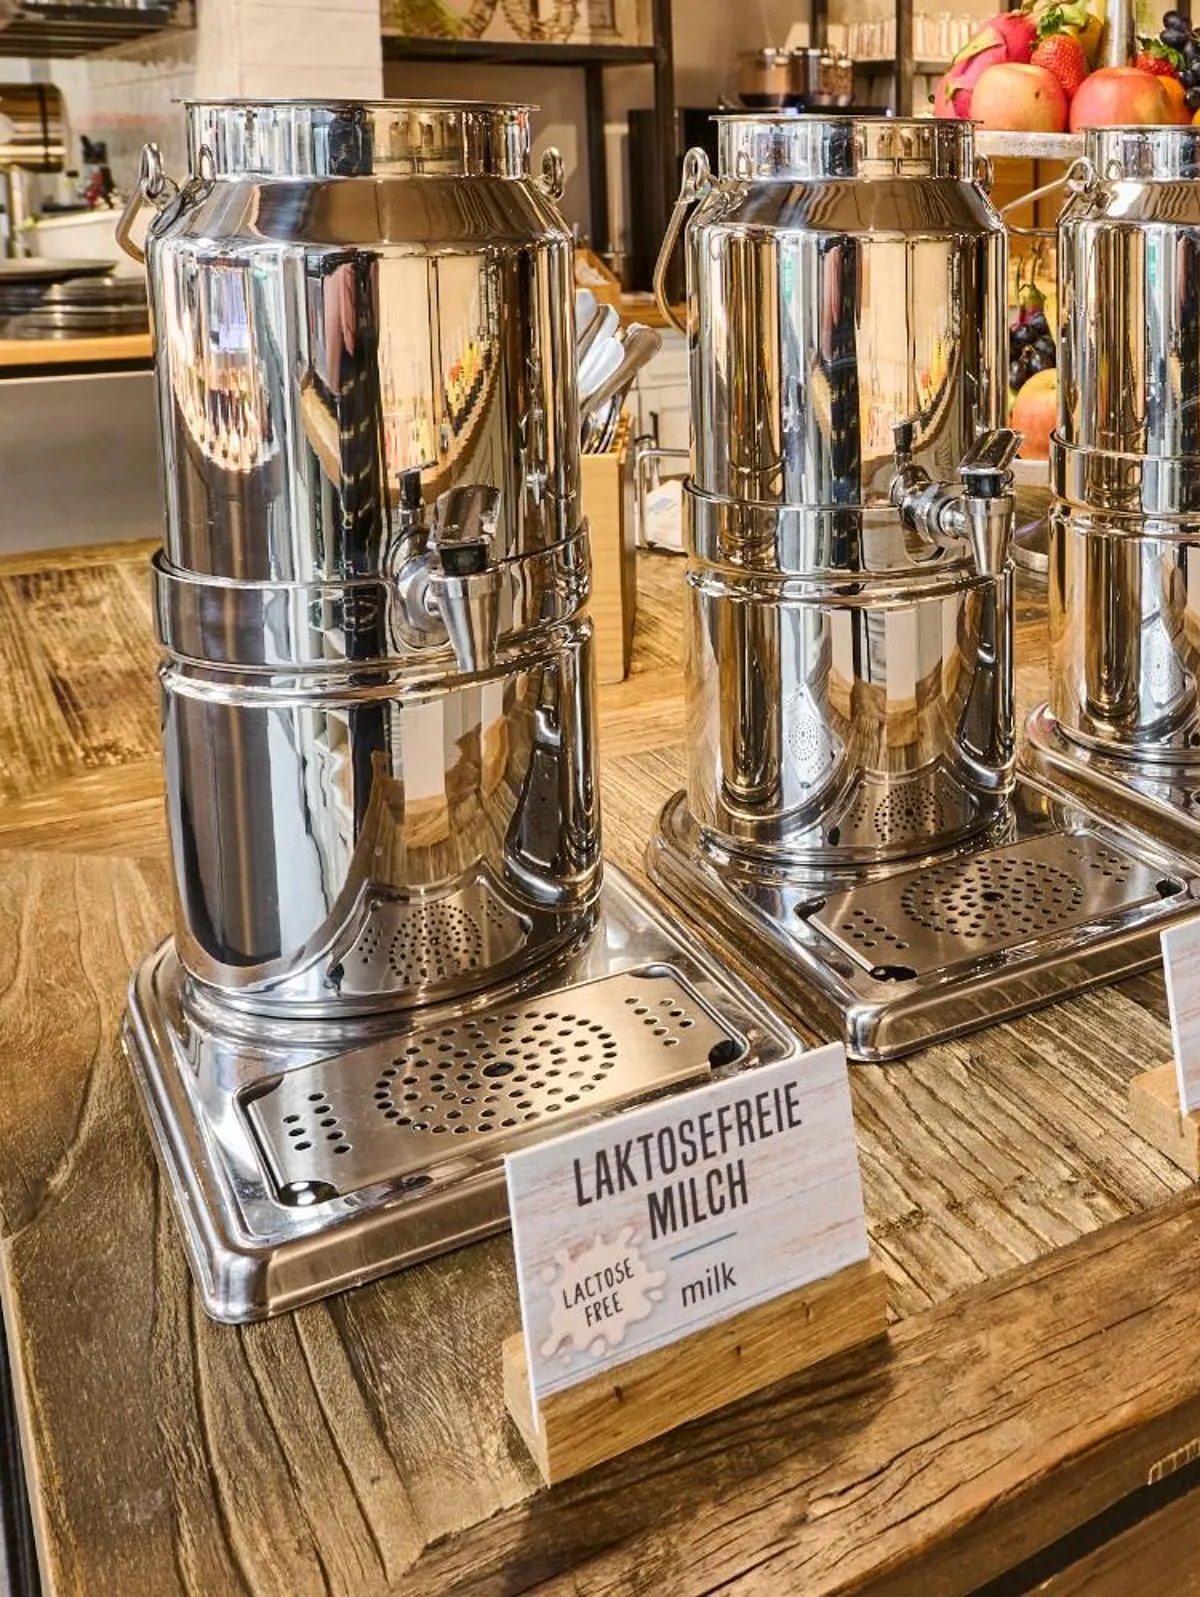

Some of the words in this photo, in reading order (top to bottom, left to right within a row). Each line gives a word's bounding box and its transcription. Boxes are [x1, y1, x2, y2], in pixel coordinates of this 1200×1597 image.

[572, 1080, 803, 1208] LAKTOSEFREIE
[646, 1158, 750, 1241] MILCH
[561, 1256, 635, 1310] LACTOSE
[583, 1291, 625, 1328] FREE
[680, 1261, 738, 1308] milk
